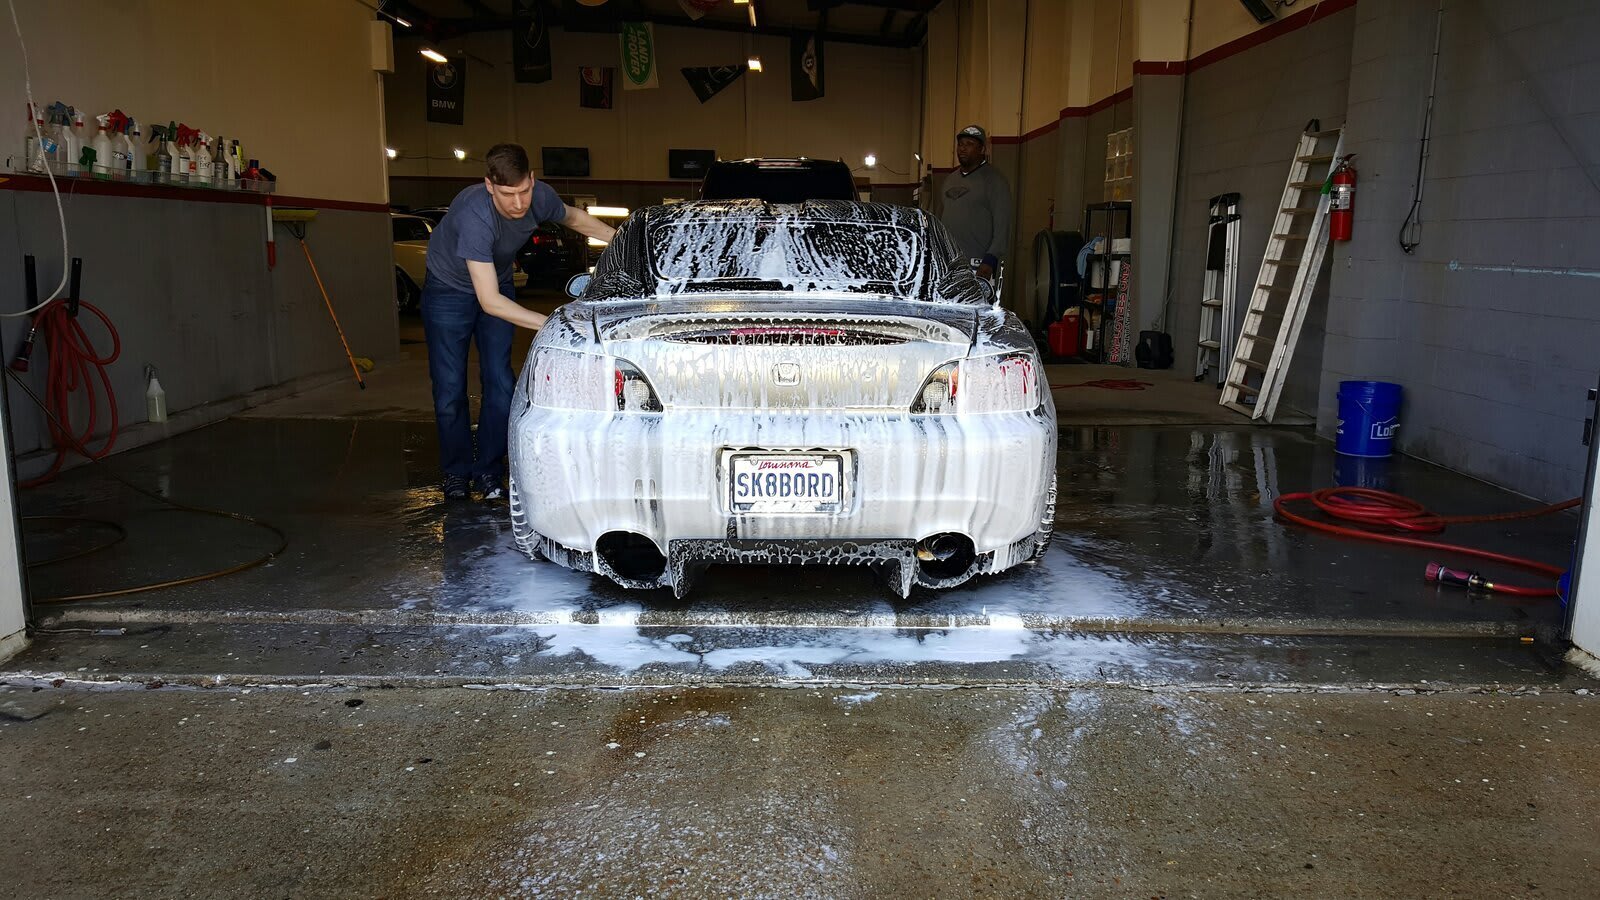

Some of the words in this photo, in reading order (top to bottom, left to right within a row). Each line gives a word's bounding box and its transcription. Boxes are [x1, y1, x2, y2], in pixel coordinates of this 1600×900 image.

[627, 34, 640, 75] ROVER
[637, 30, 649, 64] LAND
[431, 99, 456, 110] BMW
[1110, 293, 1127, 362] EMPLOYEES
[1119, 262, 1130, 291] ONLY
[758, 461, 814, 470] Louisiana
[737, 473, 833, 497] SK8BORD
